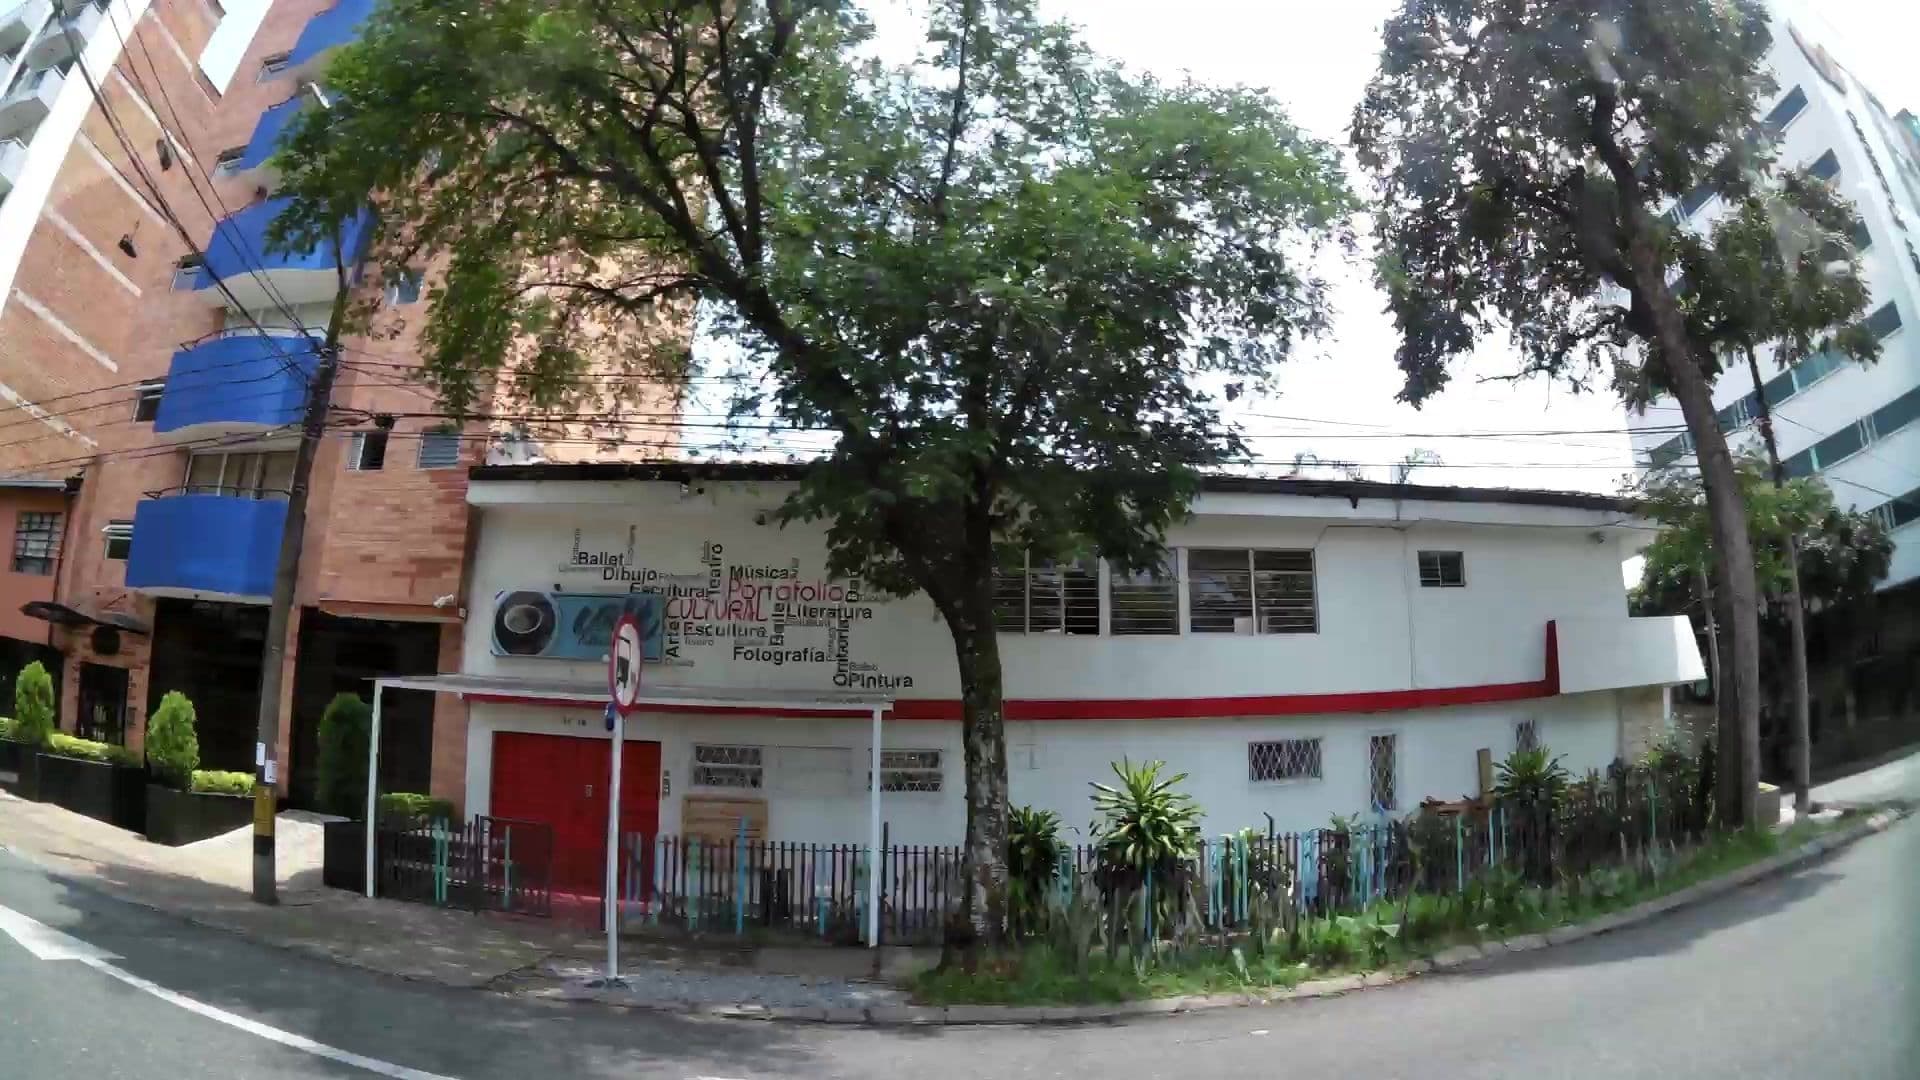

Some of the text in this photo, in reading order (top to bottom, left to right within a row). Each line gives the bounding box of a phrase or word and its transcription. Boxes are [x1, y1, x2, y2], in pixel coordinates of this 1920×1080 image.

[578, 551, 625, 566] Ballet
[603, 566, 658, 584] Dibujo
[708, 543, 723, 594] Teatro
[730, 563, 789, 580] Música
[666, 597, 768, 622] CULTURAL
[787, 602, 873, 619] Literatura
[684, 621, 768, 637] Escultura
[665, 621, 680, 657] Arte
[733, 646, 826, 666] Fotografía
[849, 673, 913, 688] Pintura
